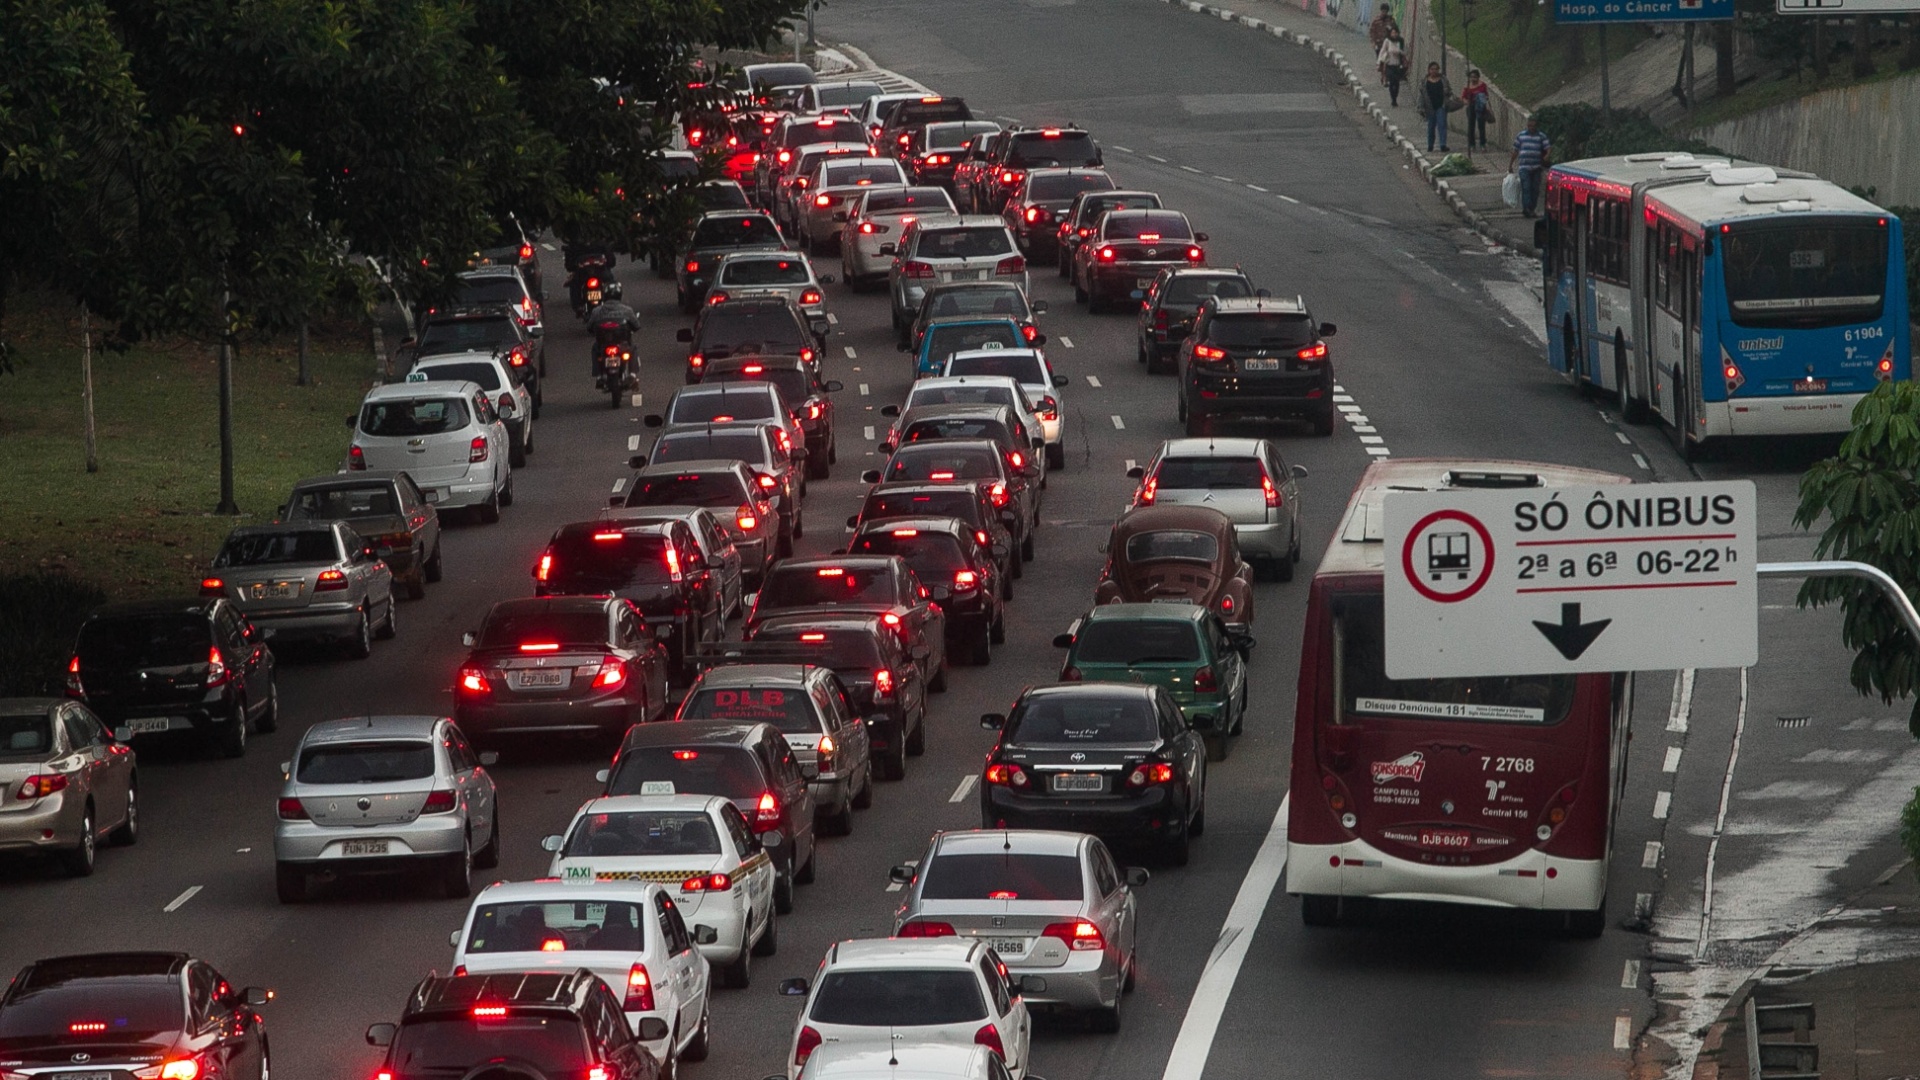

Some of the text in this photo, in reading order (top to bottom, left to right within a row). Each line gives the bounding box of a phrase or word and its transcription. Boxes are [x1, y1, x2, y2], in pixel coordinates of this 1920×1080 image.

[1560, 1, 1672, 17] Hosp. do Câncer
[1799, 299, 1815, 307] 181
[409, 373, 425, 382] TAXI
[1514, 490, 1736, 532] SÓ ÔNIBUS
[1517, 553, 1549, 579] 2ª
[1559, 558, 1576, 578] a
[1586, 550, 1618, 577] 6ª
[715, 690, 785, 707] DLB
[1364, 700, 1397, 711] Disque
[1399, 701, 1442, 714] Denúncia
[1446, 705, 1466, 716] 181
[1495, 756, 1535, 773] 2768
[1373, 787, 1420, 797] CAMPO BELO
[1482, 807, 1529, 819] Central 156
[1384, 831, 1418, 843] Mantenha
[1476, 837, 1509, 846] Distância
[566, 867, 591, 878] TAXI
